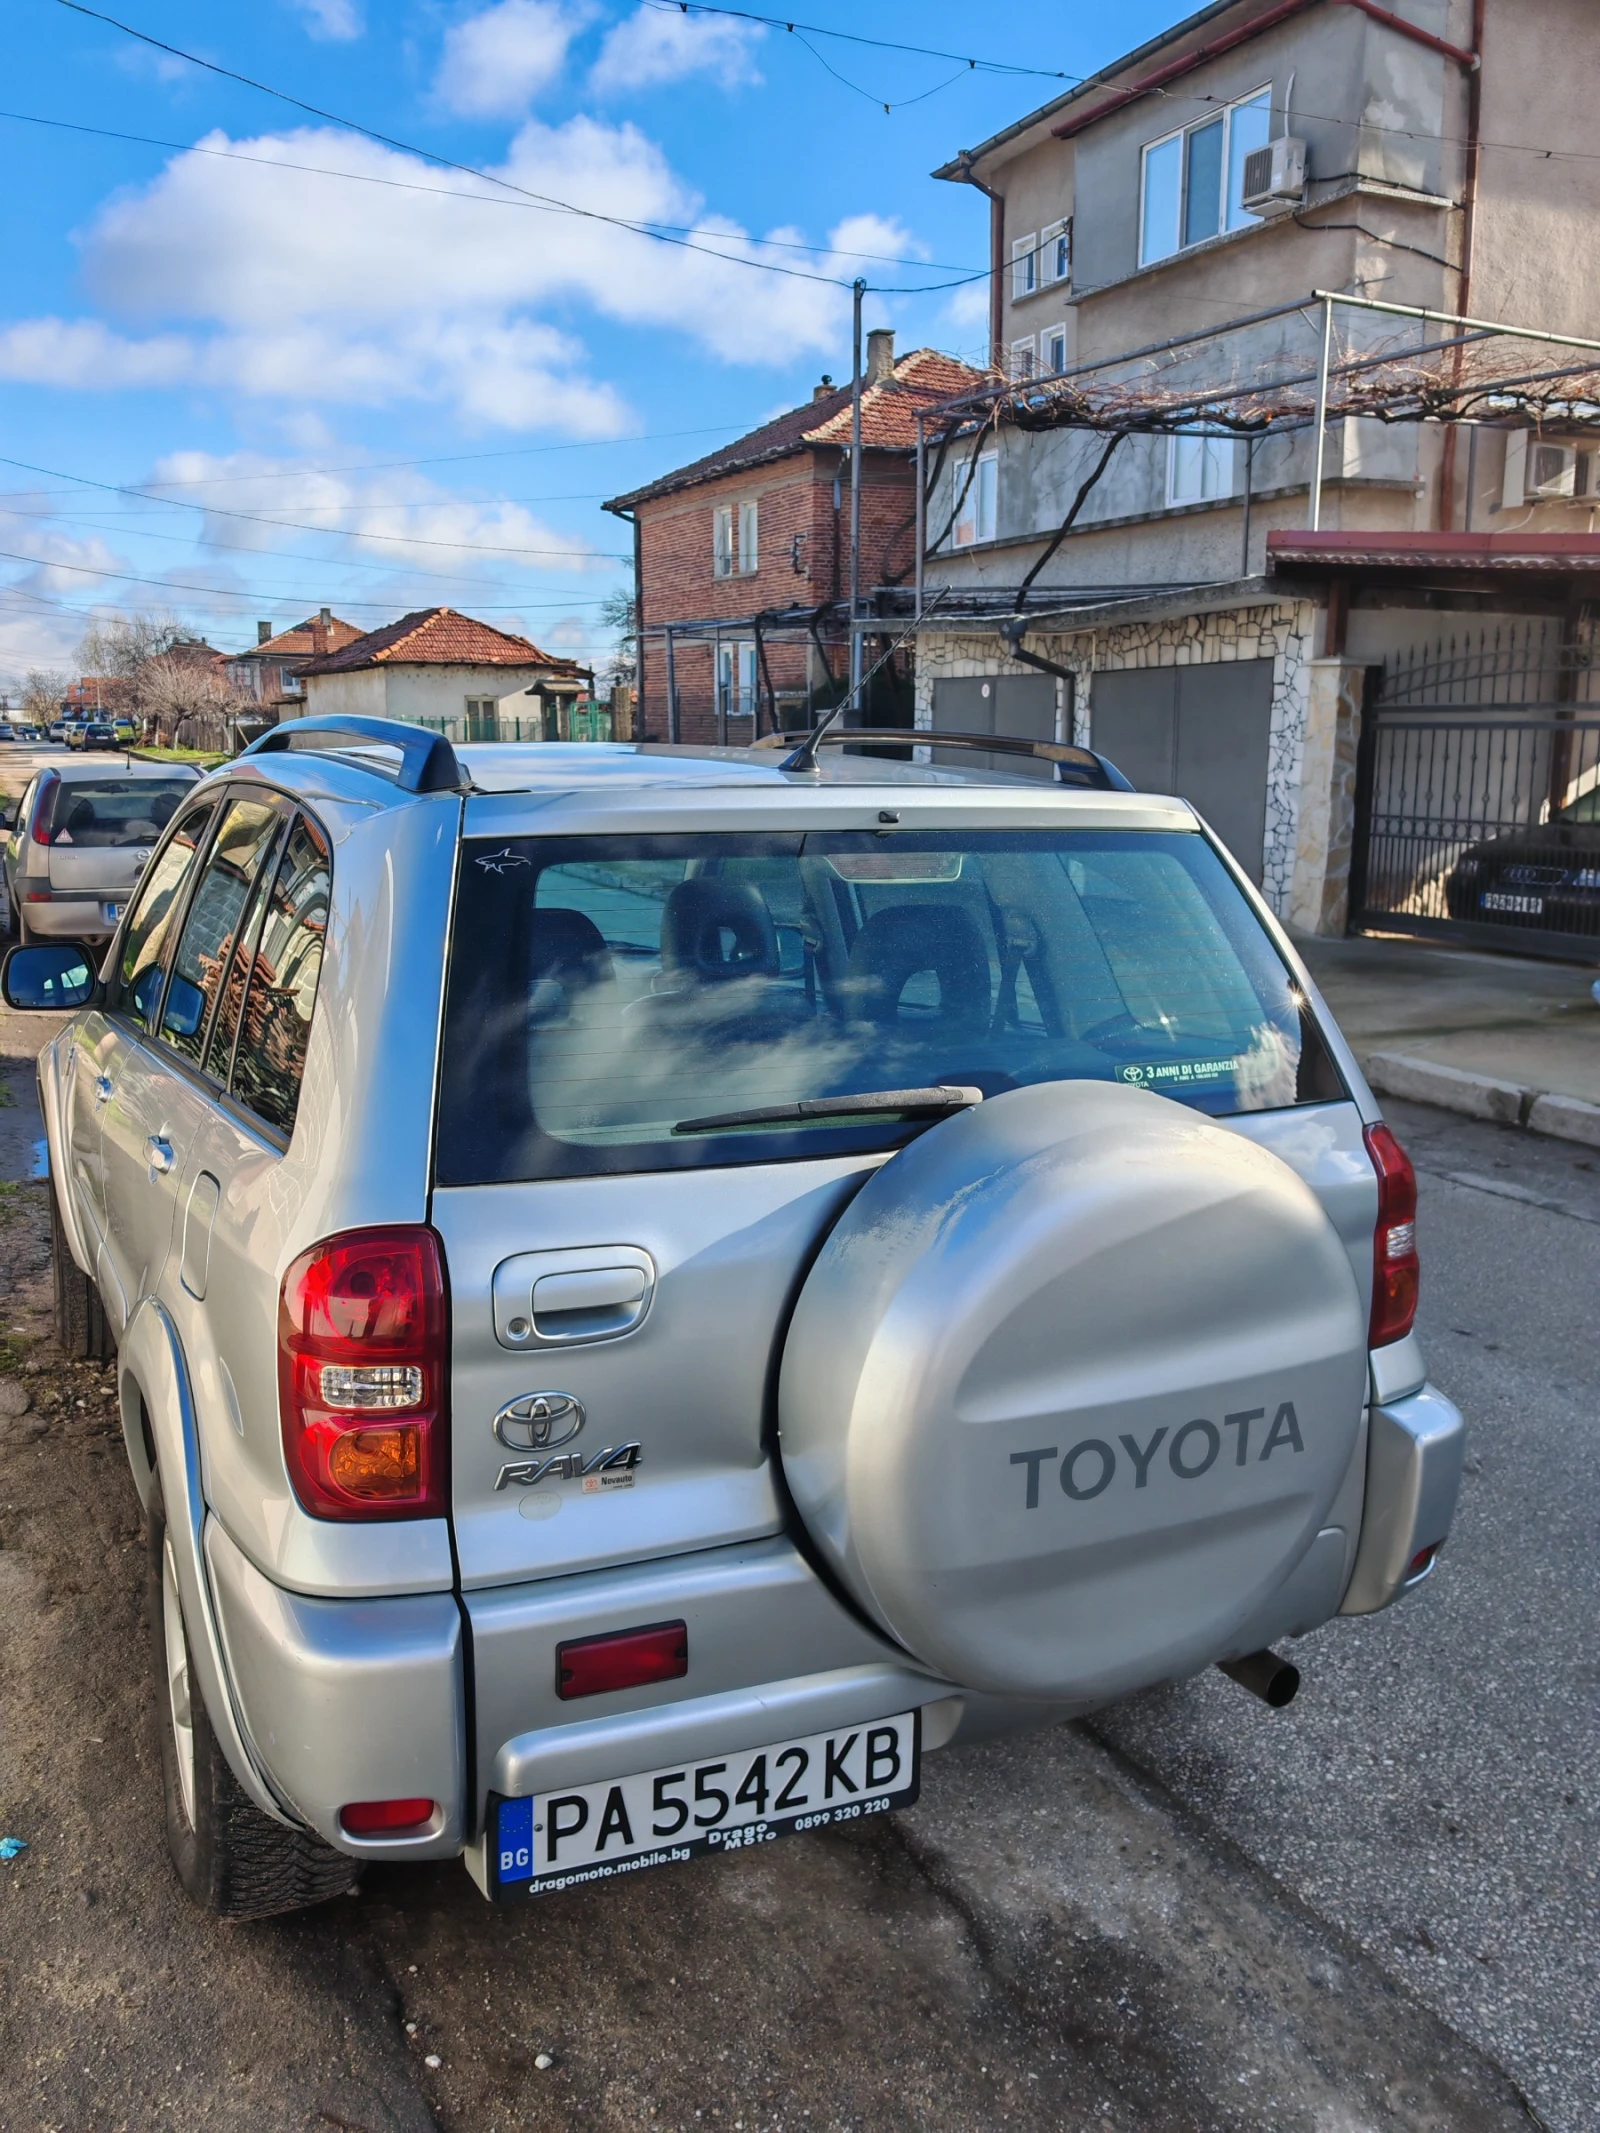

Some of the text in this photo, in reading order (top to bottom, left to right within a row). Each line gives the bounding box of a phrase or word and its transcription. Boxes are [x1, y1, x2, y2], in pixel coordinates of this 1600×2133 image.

[1147, 1060, 1240, 1079] 3 ANNI DI GARANZIA
[1126, 1081, 1149, 1089] OYOTA
[493, 1440, 643, 1491] RAV4
[1009, 1401, 1305, 1509] TOYOTA
[601, 1475, 633, 1485] Novauto
[547, 1726, 901, 1863] PA 5542 KB
[795, 1798, 890, 1831] 0899 320 220
[708, 1822, 768, 1844] Drago
[724, 1831, 777, 1851] Moto
[500, 1848, 530, 1871] BG
[528, 1848, 690, 1894] dragomoto.mobile.bg
